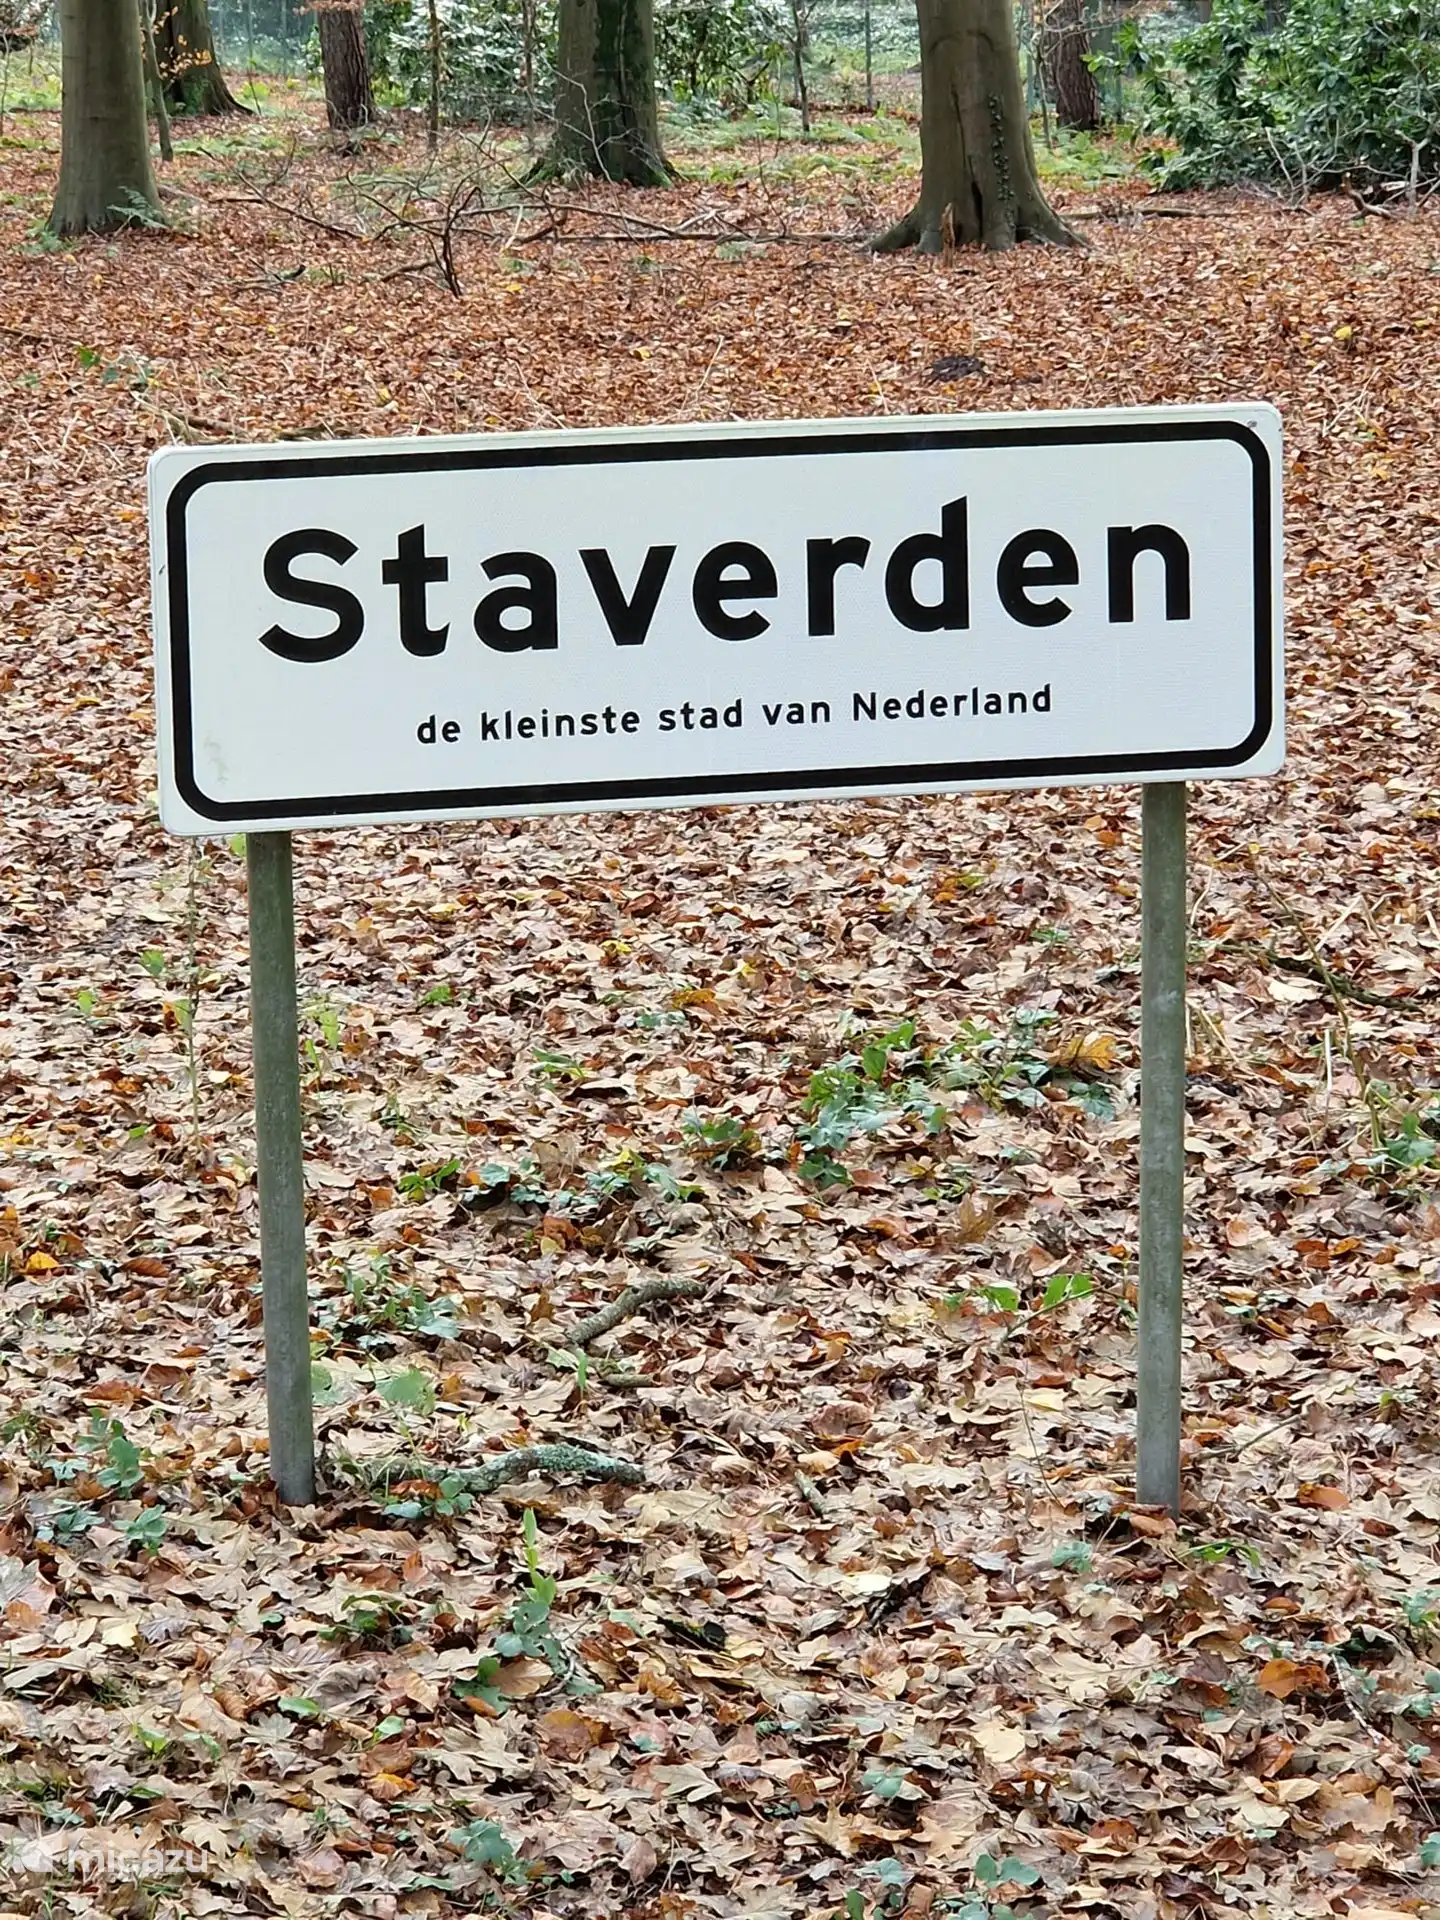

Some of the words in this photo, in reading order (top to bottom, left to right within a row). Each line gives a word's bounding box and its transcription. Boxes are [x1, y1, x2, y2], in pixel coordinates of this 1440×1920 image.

[258, 496, 1191, 664] Staverden
[417, 714, 461, 744] de
[481, 706, 640, 741] kleinste
[658, 698, 742, 731] stad
[762, 702, 830, 728] van
[853, 683, 1051, 721] Nederland
